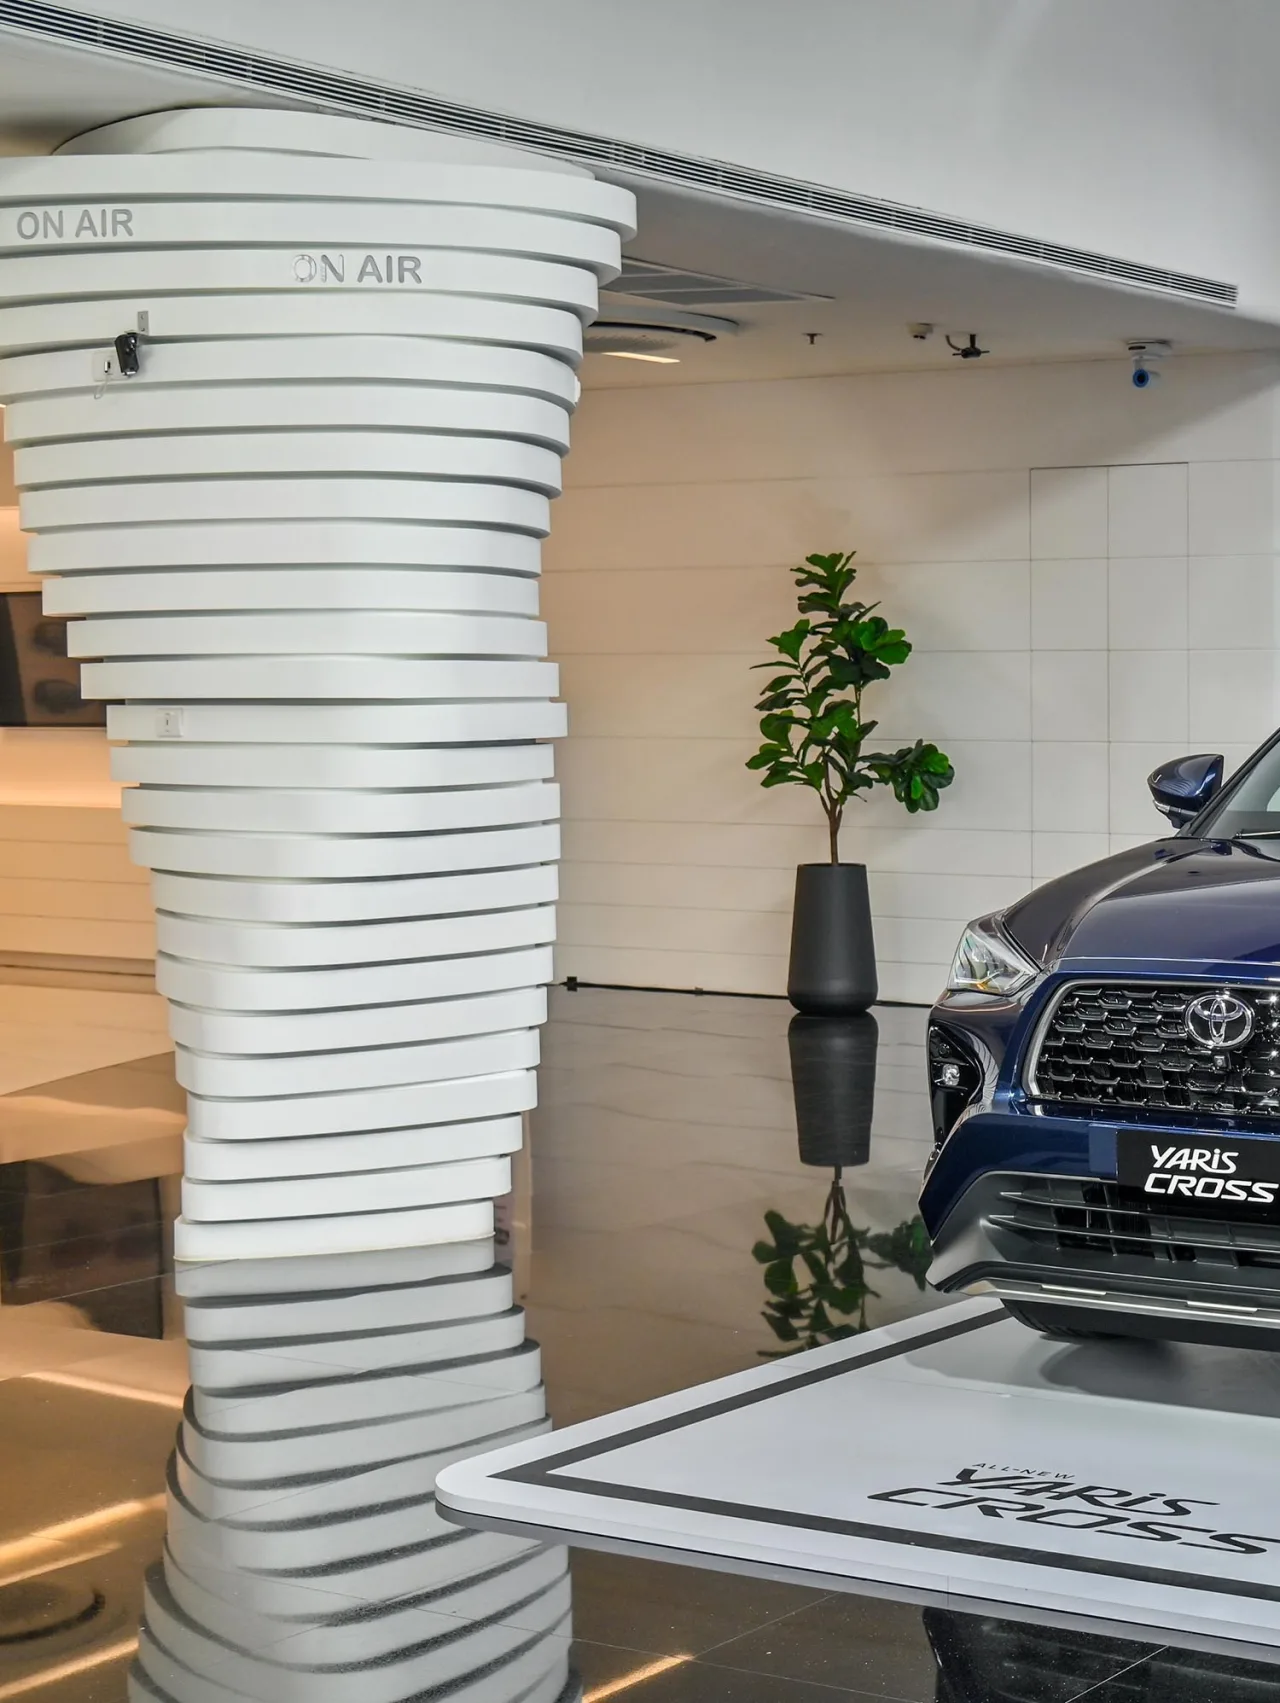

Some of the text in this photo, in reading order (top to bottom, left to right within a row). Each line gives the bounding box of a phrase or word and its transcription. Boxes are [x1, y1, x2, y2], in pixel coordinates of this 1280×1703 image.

[16, 208, 134, 240] ON AIR
[291, 253, 423, 284] ON AIR
[1144, 1172, 1280, 1203] CROSS
[971, 1462, 1075, 1480] ALL-NEW
